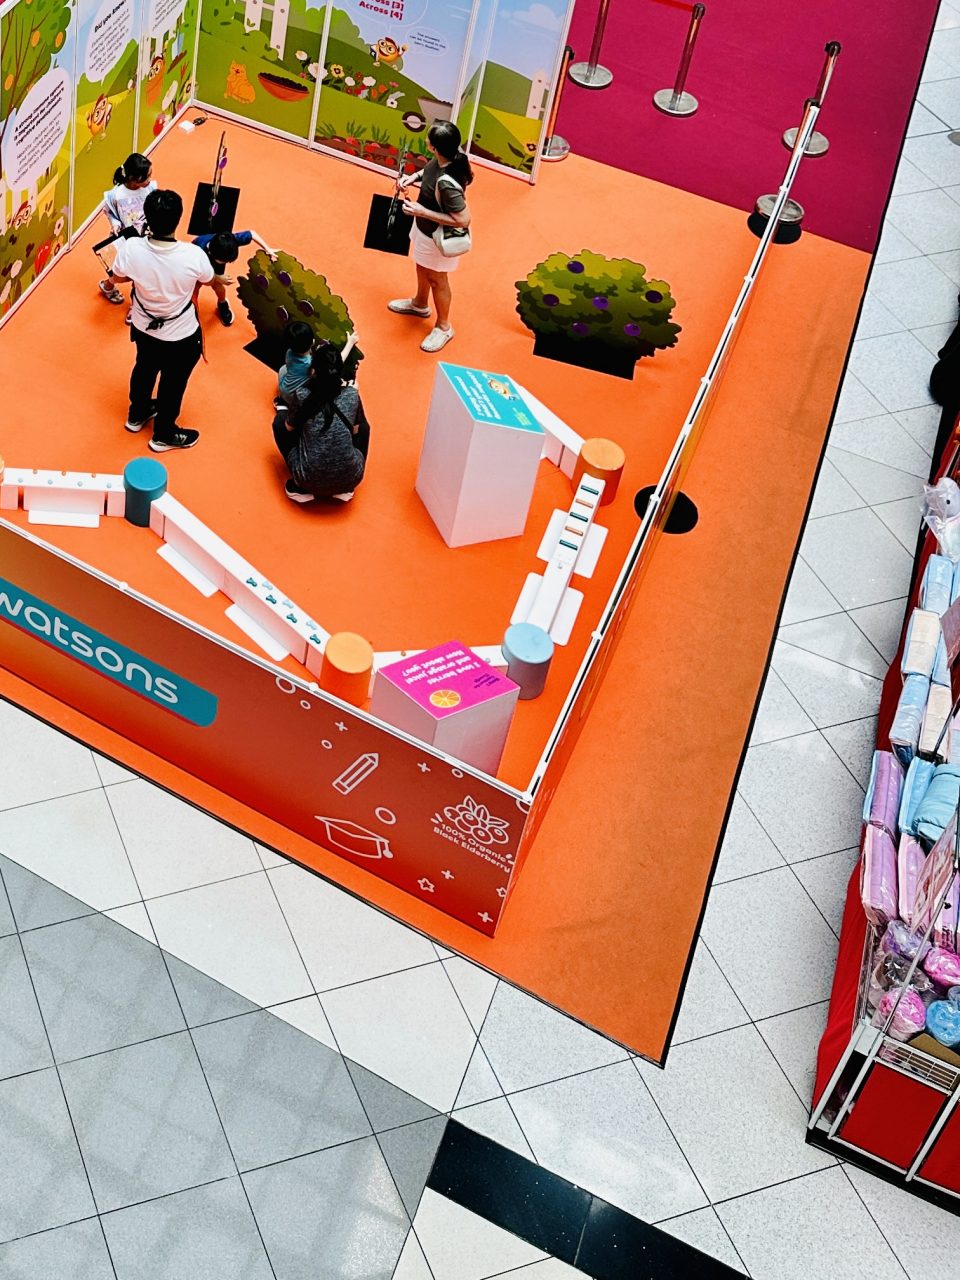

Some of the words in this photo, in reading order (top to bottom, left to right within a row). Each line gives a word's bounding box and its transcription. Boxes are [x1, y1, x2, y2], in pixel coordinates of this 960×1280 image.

[359, 1, 388, 15] Across
[390, 10, 403, 21] [4]
[392, 1, 404, 11] [3]
[443, 649, 465, 659] How
[454, 655, 473, 665] and
[419, 656, 447, 668] about
[424, 660, 457, 675] orange
[454, 663, 476, 674] love
[397, 664, 423, 676] you?
[402, 670, 429, 684] juice!
[425, 670, 458, 685] berries
[441, 824, 466, 841] 100%
[467, 838, 507, 862] Organic
[433, 827, 459, 845] Black
[461, 841, 511, 874] Elderberry
